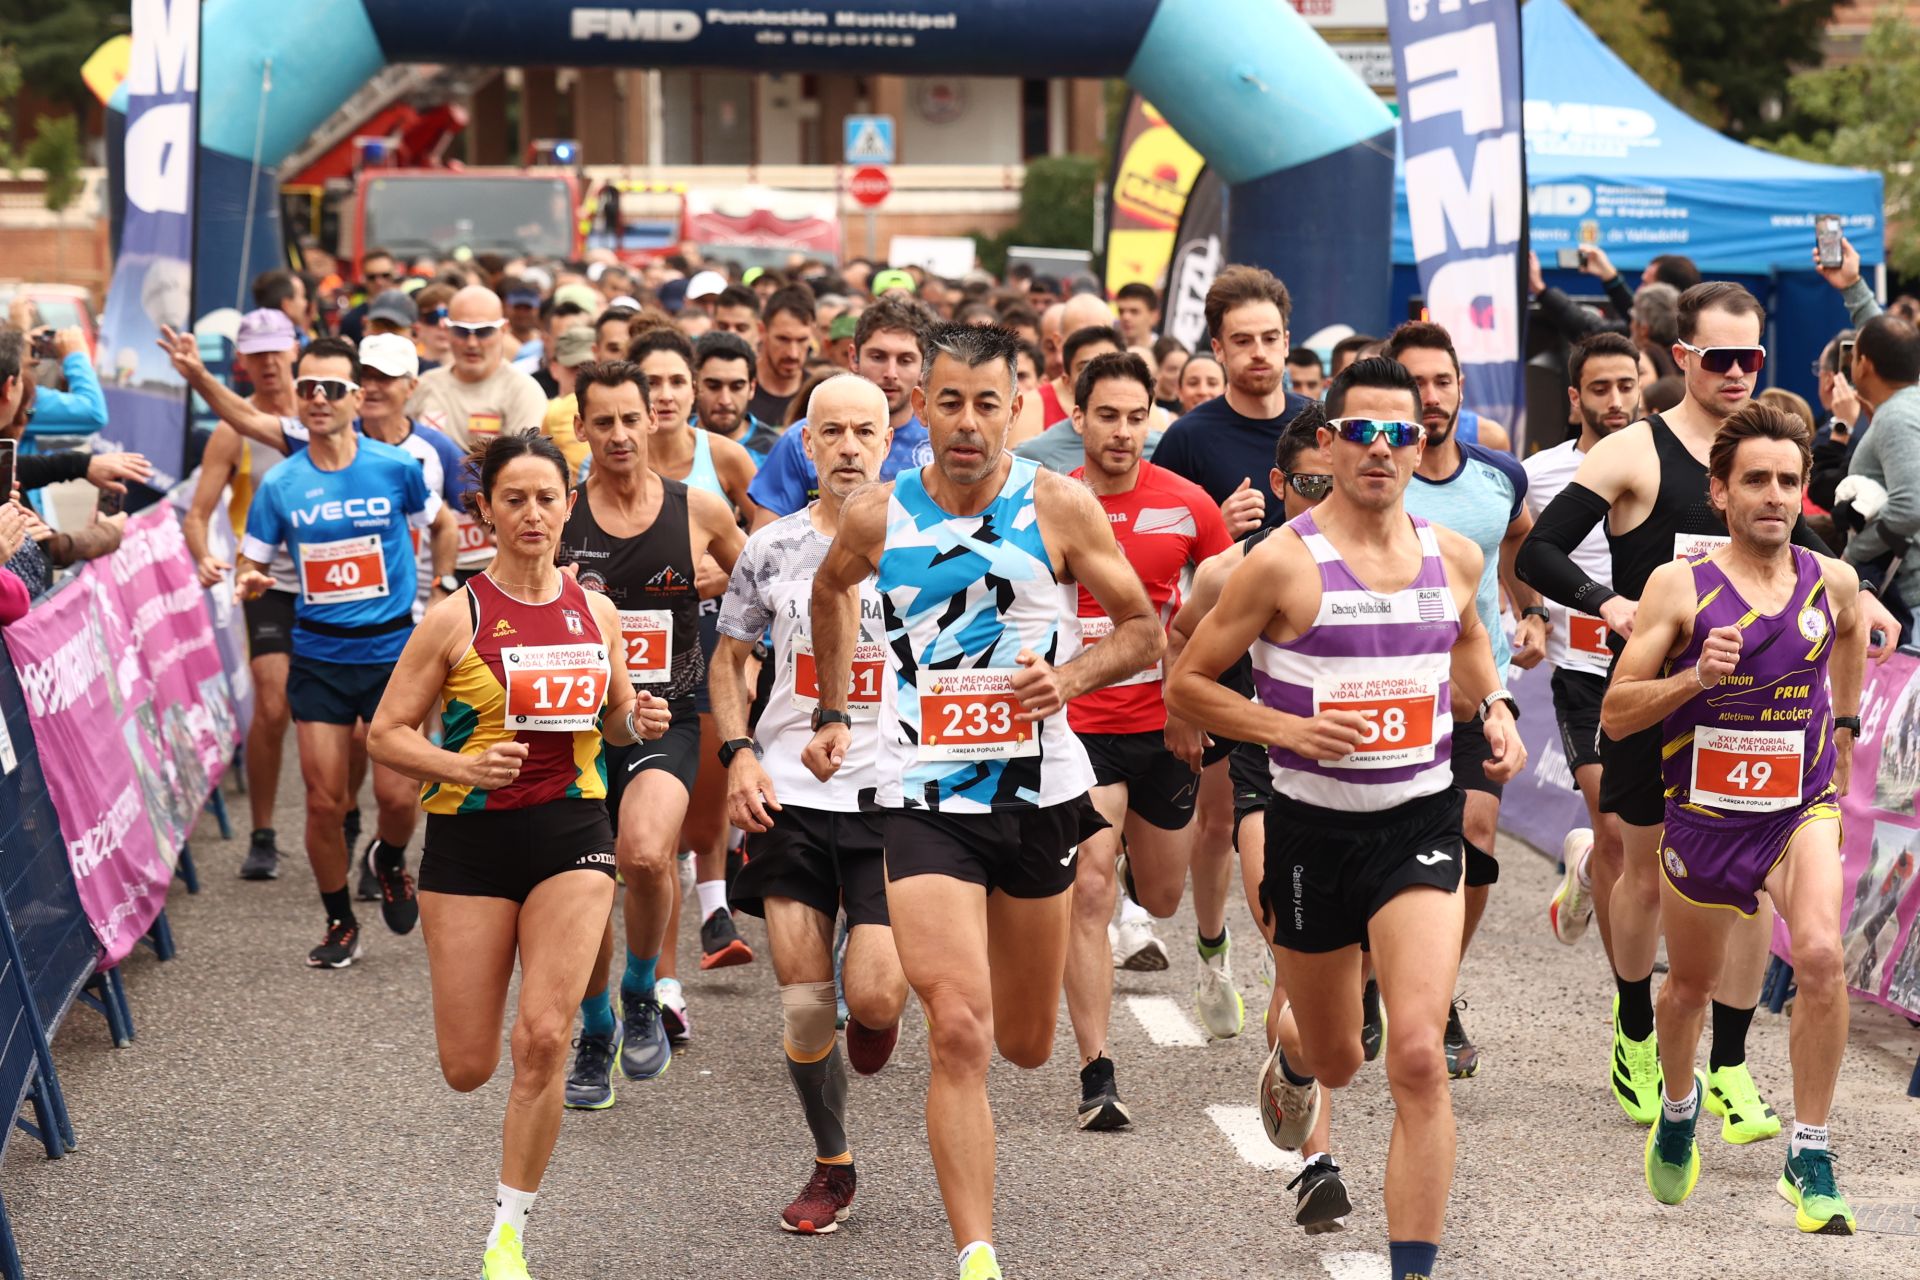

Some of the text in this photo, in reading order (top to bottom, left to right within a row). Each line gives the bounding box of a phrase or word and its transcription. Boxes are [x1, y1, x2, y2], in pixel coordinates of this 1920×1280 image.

[571, 8, 702, 41] FMD
[706, 9, 957, 30] Fundación Municipal
[755, 31, 915, 47] de Deportes
[1524, 101, 1657, 138] MD
[291, 497, 391, 528] IVECO
[1109, 512, 1127, 522] ma
[325, 561, 360, 587] 40
[1419, 591, 1440, 600] RACING
[1332, 602, 1391, 618] Racing Valladolid
[547, 650, 596, 659] MEMORIAL
[856, 645, 882, 653] ORIAL
[938, 676, 959, 684] XXIX
[1340, 678, 1418, 690] XXIX MEMORIAL
[1720, 672, 1754, 686] amón
[532, 676, 596, 709] 173
[929, 683, 1014, 693] VAL-MATARRA
[1330, 685, 1427, 698] VIDAL-MATARRANZ
[1774, 685, 1810, 700] PRIM
[942, 702, 1011, 737] 233
[1719, 706, 1813, 722] Atletismo Macotera
[1708, 741, 1795, 752] VIDAL-MATARRANZ
[1717, 735, 1786, 745] XXIX MEMORIAL
[1382, 753, 1408, 761] POPULAR
[1726, 760, 1772, 791] 49
[1719, 796, 1745, 805] CARRERA
[1295, 906, 1305, 930] León
